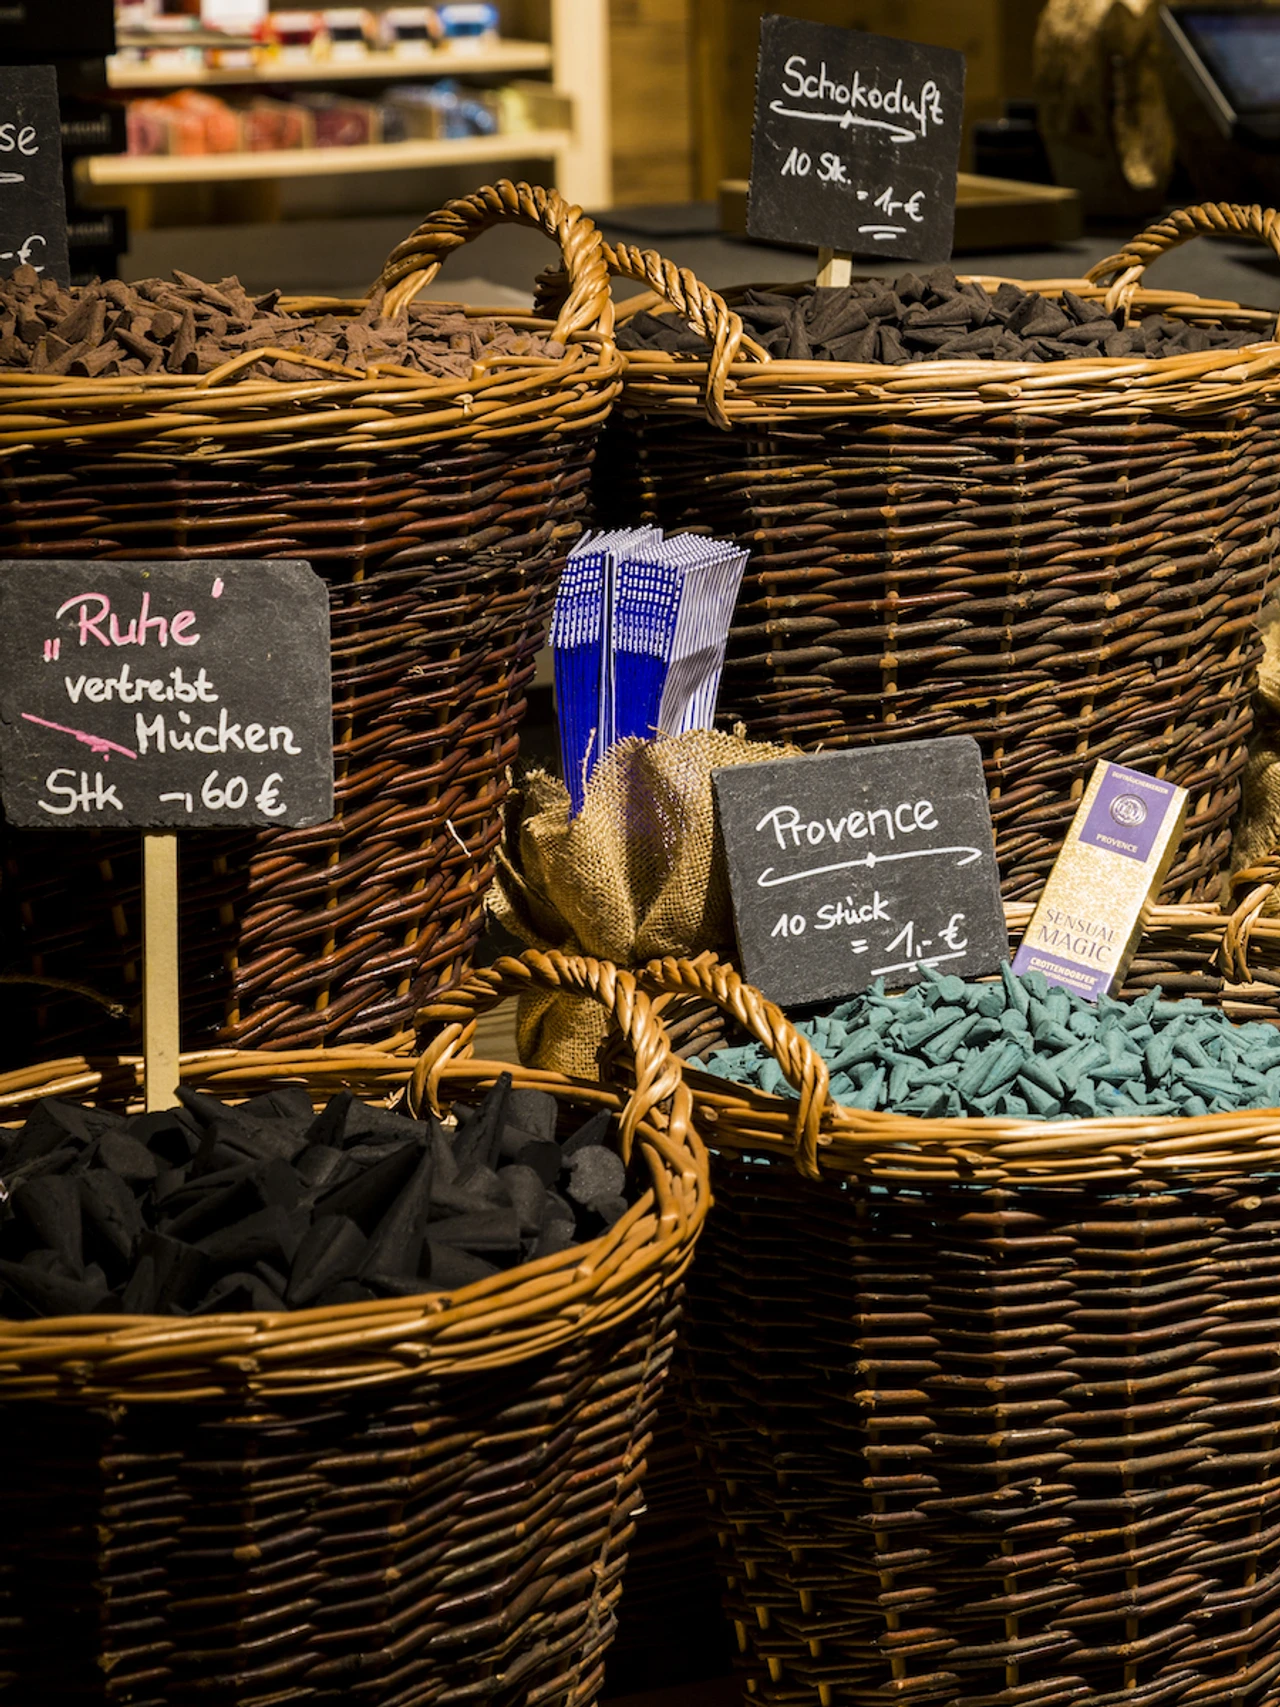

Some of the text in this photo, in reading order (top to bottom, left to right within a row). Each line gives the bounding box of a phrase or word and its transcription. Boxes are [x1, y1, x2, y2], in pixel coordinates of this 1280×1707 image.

[782, 55, 944, 136] Schokoduft
[781, 147, 811, 176] 10
[64, 663, 219, 704] vertreibt
[135, 707, 302, 755] Mücken
[37, 767, 124, 815] Stk
[755, 800, 939, 850] Provence
[1096, 833, 1139, 854] PROVENCE
[770, 891, 892, 938] 10 Stück
[1046, 908, 1116, 943] SENSUAL
[851, 938, 869, 954] =
[1037, 925, 1112, 963] MAGIC
[1029, 956, 1098, 986] CROTTENDORFER
